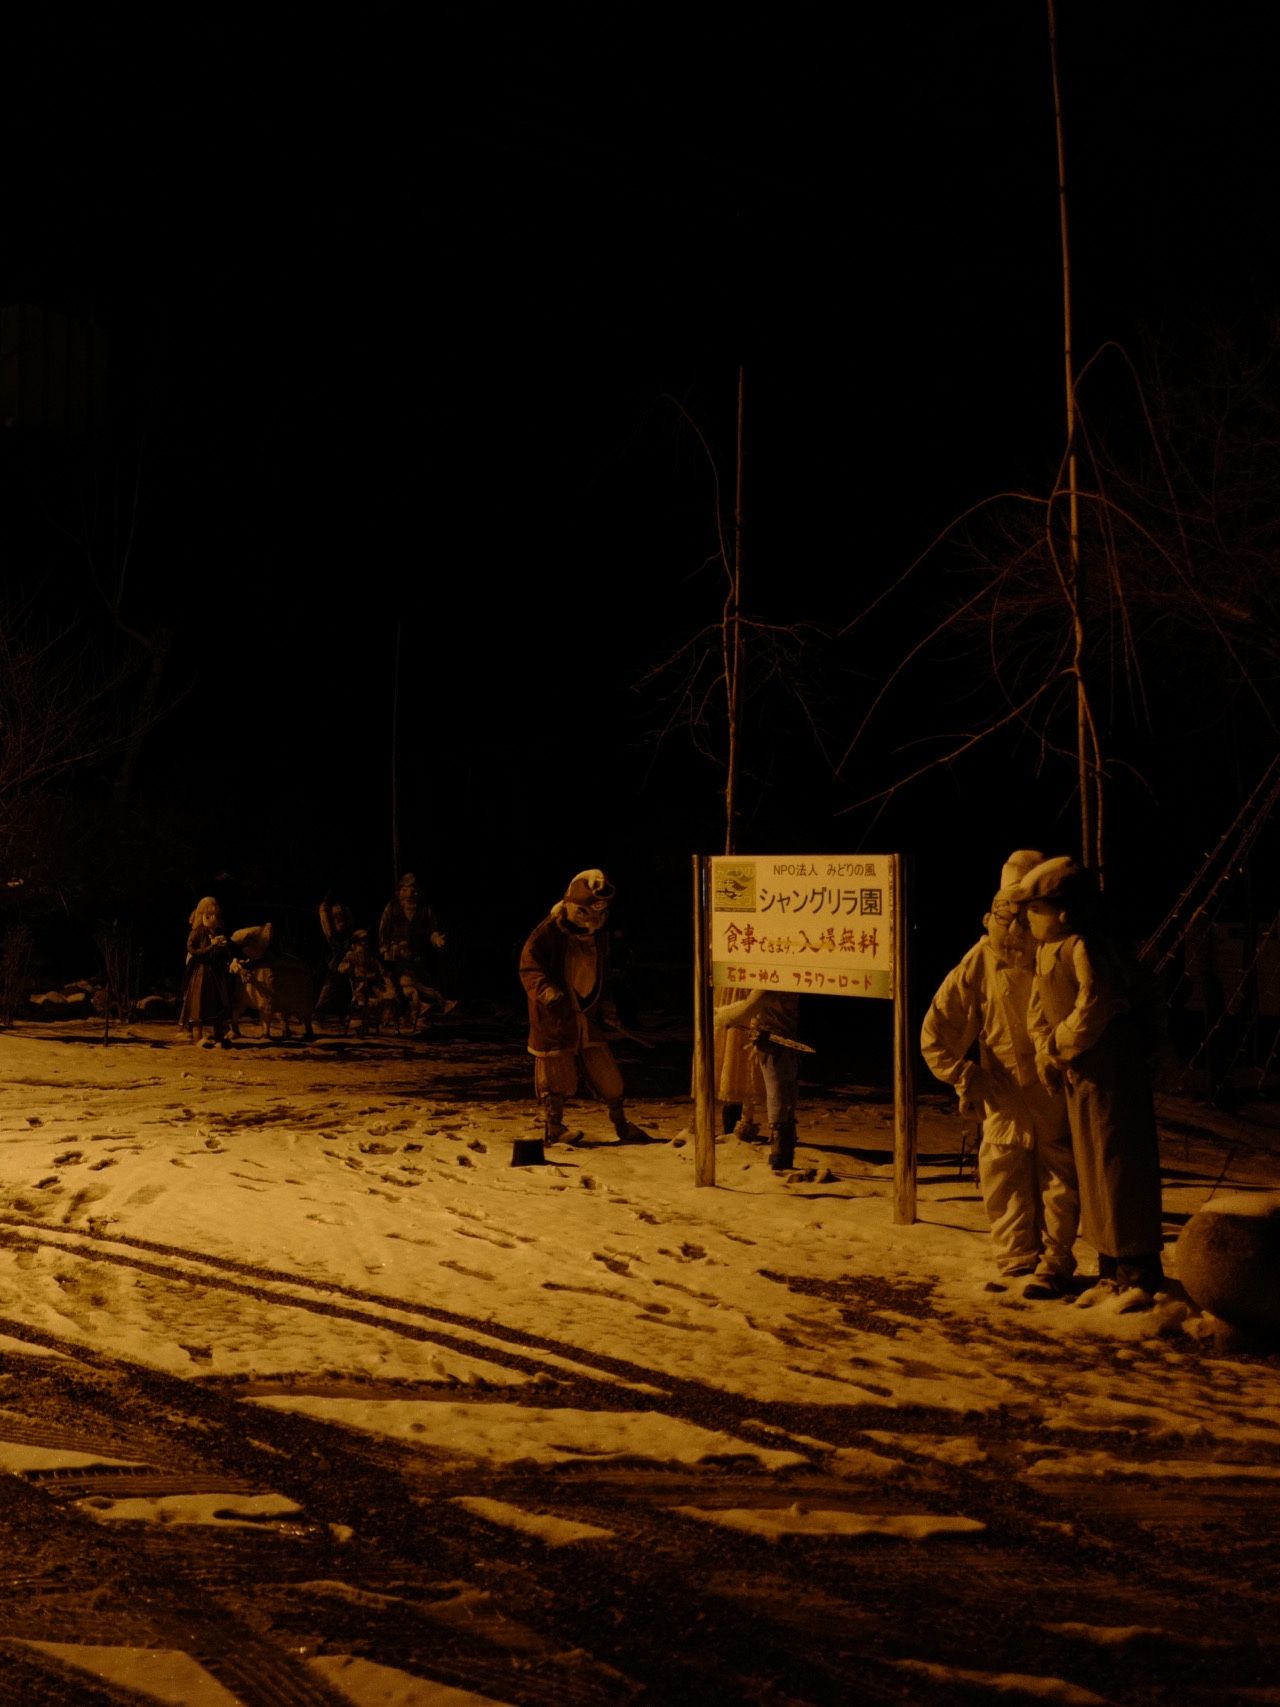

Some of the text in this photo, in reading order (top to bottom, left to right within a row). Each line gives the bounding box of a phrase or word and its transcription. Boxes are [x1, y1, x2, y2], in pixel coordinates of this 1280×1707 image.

[773, 863, 877, 877] NPO法人 みどりの風
[758, 887, 883, 916] シャングリラ園
[798, 927, 880, 959] 入場無料
[792, 971, 873, 991] フラワーロード
